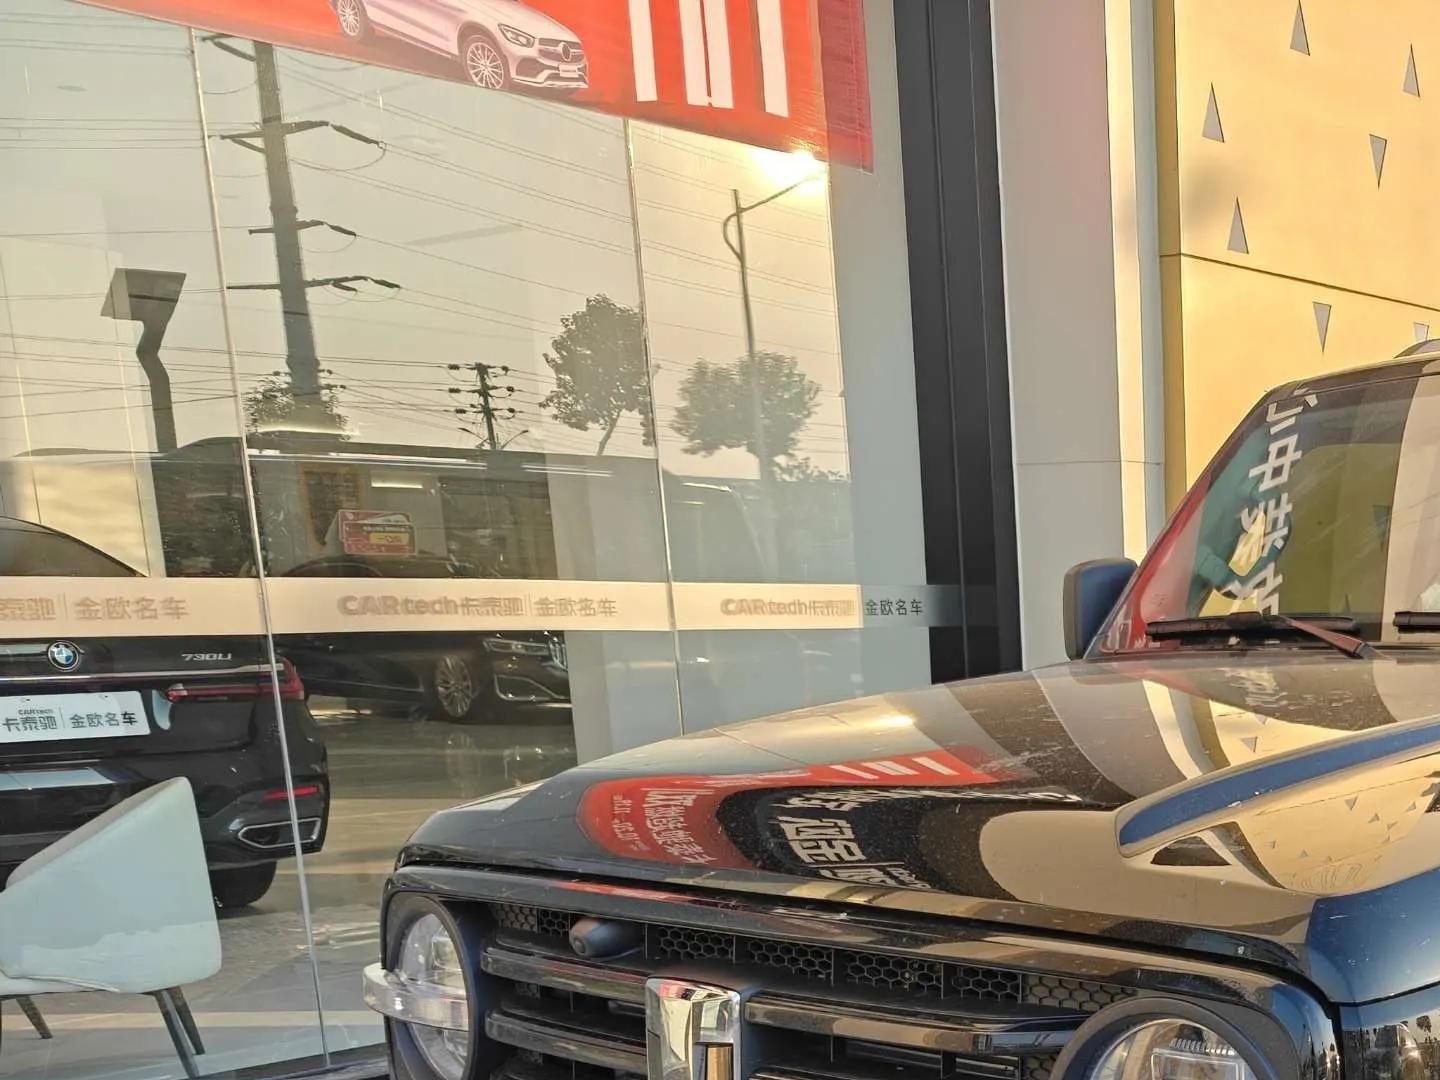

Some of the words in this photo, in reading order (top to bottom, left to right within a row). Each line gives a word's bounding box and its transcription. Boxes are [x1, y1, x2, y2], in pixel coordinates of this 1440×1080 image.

[73, 596, 190, 621] 金欧名车
[336, 594, 459, 617] CARtech
[533, 597, 618, 617] 金欧名车
[865, 599, 924, 616] 金欧名车
[2, 716, 58, 732] 卡泰驰
[69, 711, 138, 729] 金欧名车
